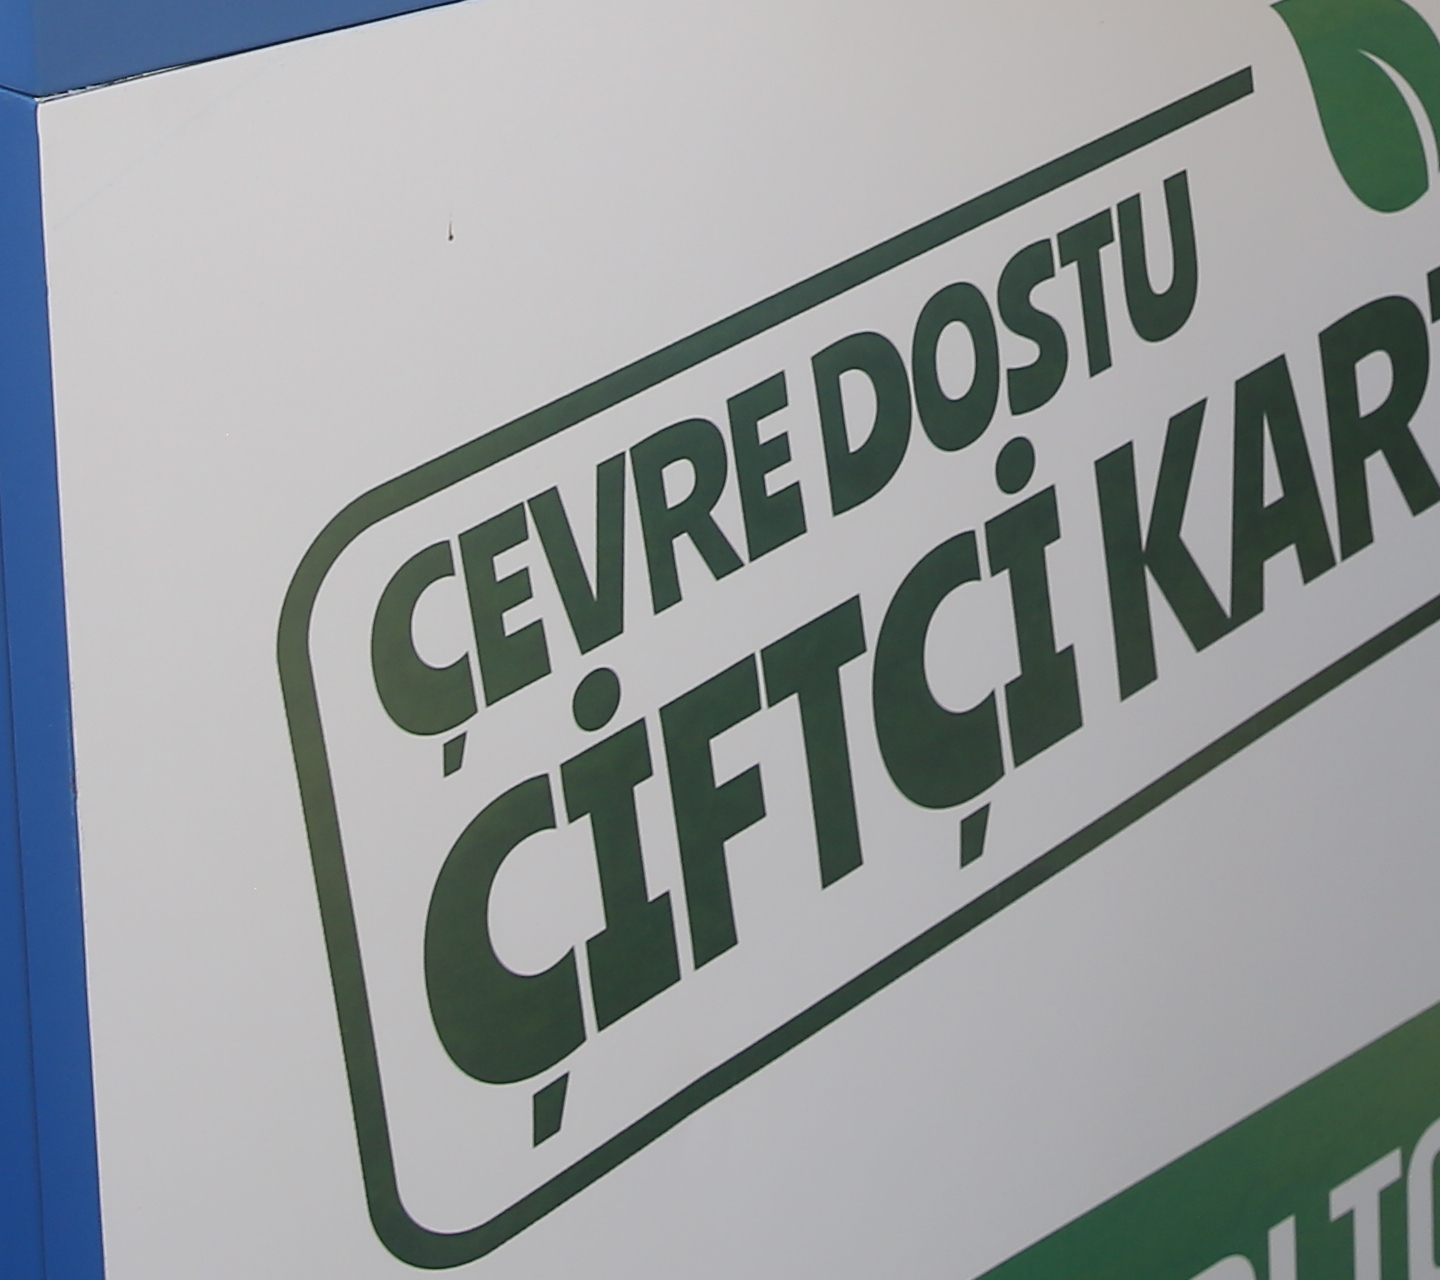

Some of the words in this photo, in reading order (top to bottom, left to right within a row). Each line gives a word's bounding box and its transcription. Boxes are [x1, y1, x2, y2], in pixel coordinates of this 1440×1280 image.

[371, 370, 807, 778] ÇEVRE
[810, 169, 1199, 517] DOSTU
[423, 436, 1084, 1149] ÇİFTÇİ
